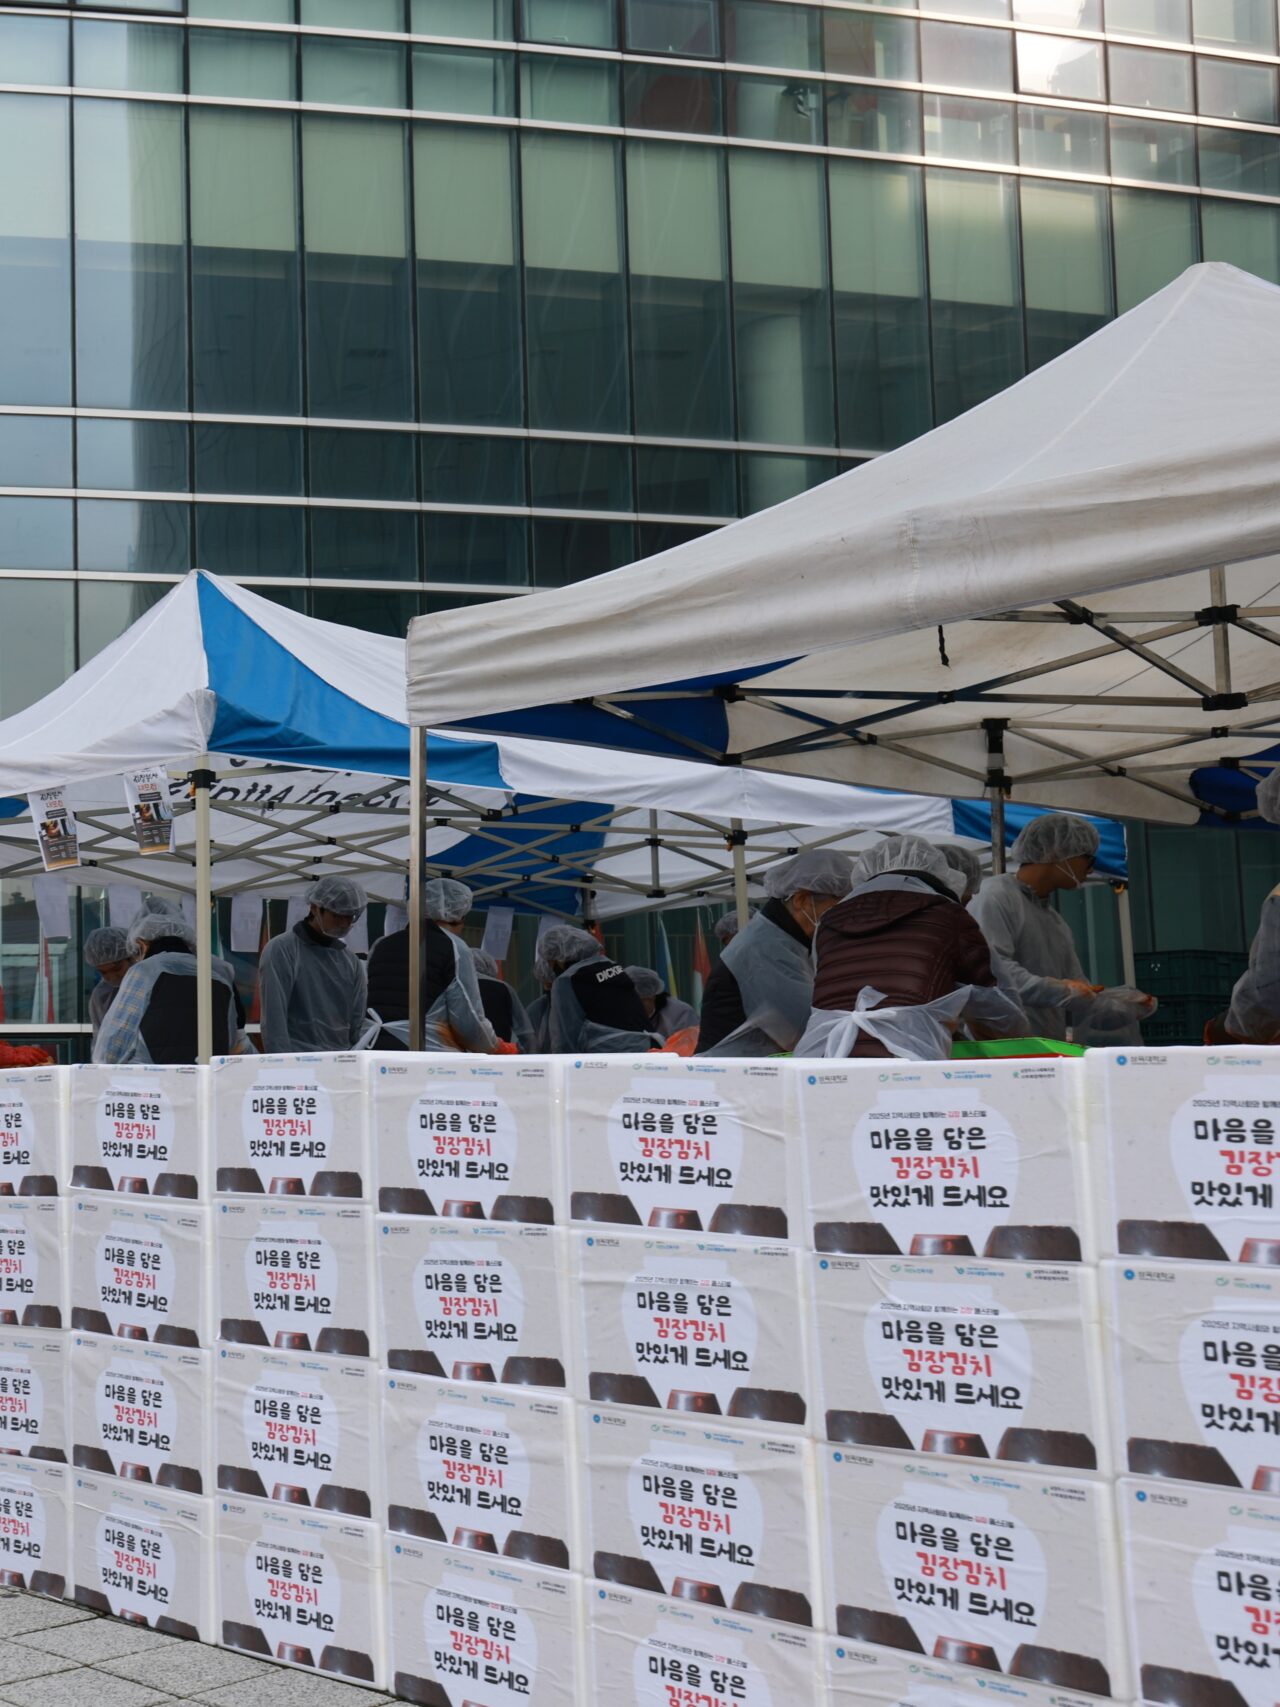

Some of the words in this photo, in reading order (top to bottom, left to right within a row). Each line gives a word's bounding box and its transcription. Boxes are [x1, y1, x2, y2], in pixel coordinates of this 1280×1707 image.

[253, 1098, 287, 1115] 마음을
[293, 1097, 316, 1114] 담은
[922, 1111, 947, 1119] 함께하는
[1192, 1098, 1221, 1108] 2025년
[5, 1113, 22, 1128] 담은
[263, 1119, 311, 1136] 김장김치
[420, 1113, 461, 1132] 마음을
[469, 1114, 496, 1133] 담은
[623, 1112, 674, 1134] 마음을
[683, 1114, 717, 1135] 담은
[1194, 1118, 1275, 1145] 마음을
[250, 1140, 285, 1157] 맛있게
[290, 1141, 326, 1158] 드세요
[433, 1136, 490, 1156] 김장김치
[639, 1138, 709, 1160] 김장김치
[871, 1128, 933, 1151] 마음을
[944, 1127, 986, 1150] 담은
[3, 1151, 30, 1165] 드세요
[418, 1158, 459, 1178] 맛있게
[465, 1162, 509, 1181] 드세요
[891, 1157, 979, 1179] 김장김치
[1220, 1150, 1280, 1178] 김장
[620, 1162, 671, 1183] 맛있게
[678, 1166, 733, 1188] 드세요
[870, 1185, 933, 1207] 맛있게
[943, 1185, 1010, 1207] 드세요
[1191, 1181, 1272, 1208] 맛있게
[105, 1248, 135, 1267] 마음을
[141, 1253, 161, 1270] 담은
[114, 1268, 155, 1290] 김장김치
[425, 1273, 467, 1292] 마음을
[474, 1274, 502, 1293] 담은
[102, 1286, 132, 1306] 맛있게
[136, 1293, 168, 1313] 드세요
[439, 1297, 497, 1316] 김장김치
[637, 1291, 688, 1314] 마음을
[697, 1295, 731, 1316] 담은
[426, 1320, 468, 1339] 맛있게
[474, 1322, 518, 1342] 드세요
[654, 1318, 725, 1342] 김장김치
[882, 1320, 945, 1345] 마음을
[956, 1324, 998, 1348] 담은
[1200, 1318, 1230, 1330] 2025년
[636, 1342, 687, 1365] 맛있게
[695, 1348, 750, 1371] 드세요
[903, 1349, 991, 1377] 김장김치
[882, 1377, 945, 1403] 맛있게
[955, 1383, 1022, 1409] 드세요
[1230, 1374, 1280, 1410] 김장
[255, 1399, 291, 1420] 마음을
[297, 1405, 321, 1424] 담은
[266, 1422, 315, 1446] 김장김치
[252, 1442, 288, 1463] 맛있게
[293, 1449, 332, 1471] 드세요
[430, 1436, 472, 1459] 마음을
[479, 1443, 508, 1465] 담은
[443, 1460, 502, 1488] 김장김치
[428, 1481, 471, 1506] 맛있게
[477, 1491, 522, 1517] 드세요
[643, 1475, 694, 1502] 마음을
[703, 1484, 737, 1509] 담은
[659, 1502, 730, 1535] 김장김치
[641, 1526, 692, 1554] 맛있게
[700, 1537, 754, 1566] 드세요
[896, 1521, 959, 1552] 마음을
[970, 1533, 1013, 1561] 담은
[916, 1552, 1005, 1590] 김장김치
[895, 1578, 959, 1611] 맛있게
[968, 1592, 1037, 1627] 드세요
[1217, 1571, 1280, 1608] 마음
[437, 1605, 480, 1632] 마음을
[487, 1616, 516, 1641] 담은
[450, 1631, 510, 1664] 김장김치
[1216, 1635, 1280, 1675] 맛있
[435, 1651, 478, 1680] 맛있게
[484, 1665, 530, 1695] 드세요
[649, 1656, 701, 1688] 마음을
[710, 1670, 746, 1698] 담은
